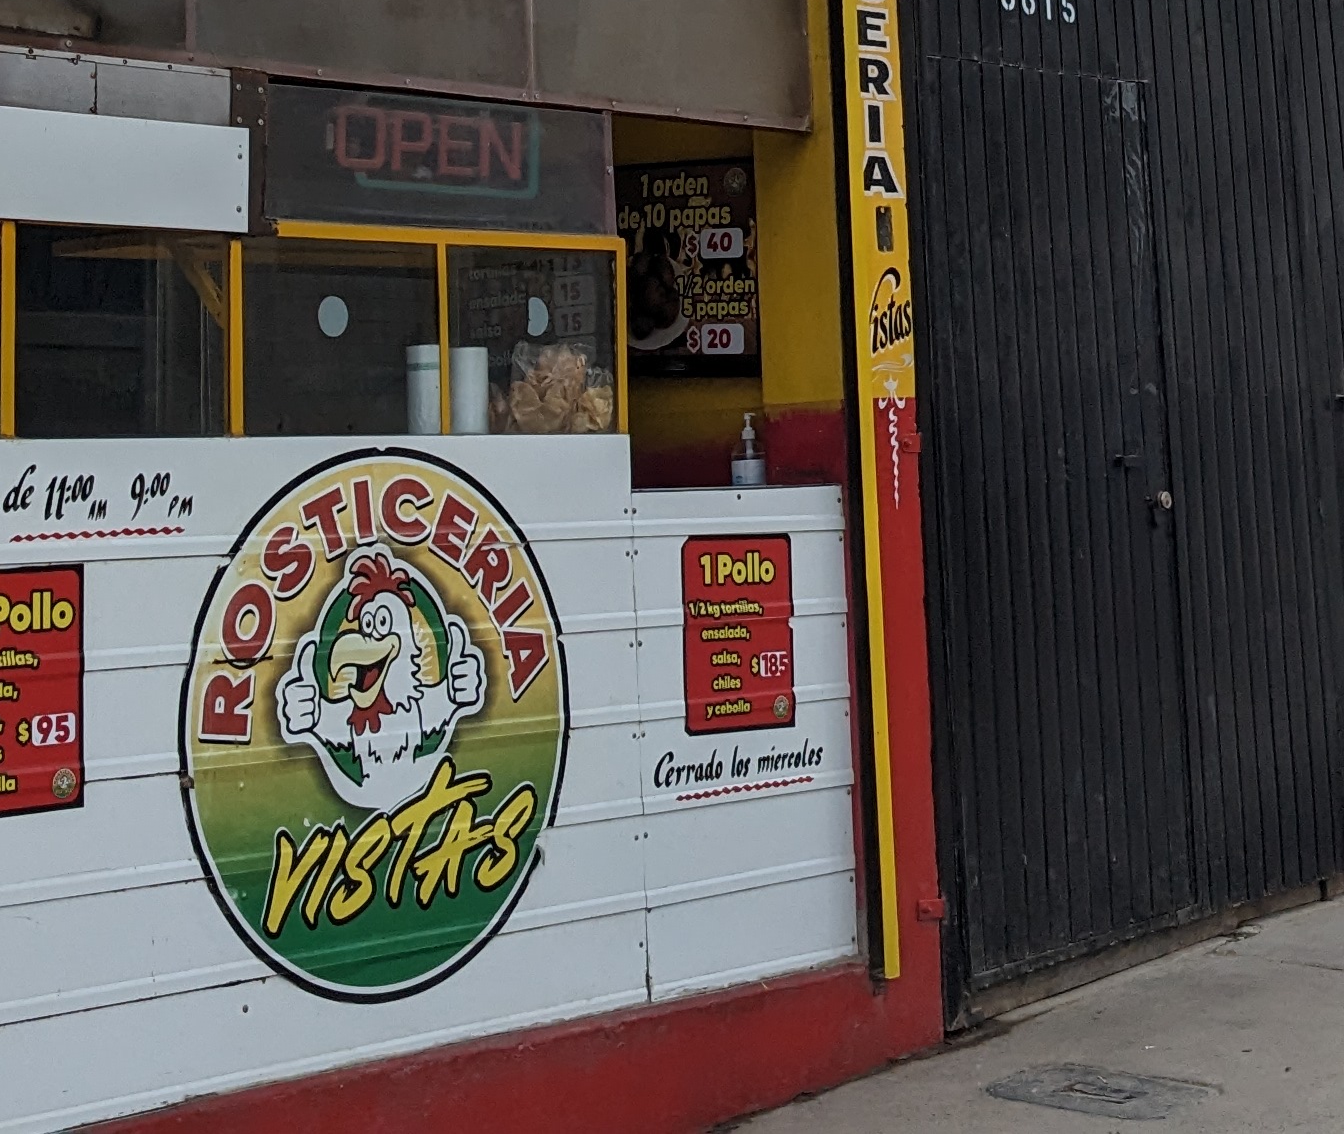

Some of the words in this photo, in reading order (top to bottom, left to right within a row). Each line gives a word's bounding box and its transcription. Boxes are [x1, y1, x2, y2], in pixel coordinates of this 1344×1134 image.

[335, 106, 522, 180] OPEN
[641, 174, 648, 197] 1
[653, 172, 708, 195] orden
[618, 206, 639, 229] de
[644, 203, 665, 228] 10
[670, 206, 730, 233] papas
[677, 276, 704, 296] 1/2
[706, 276, 755, 294] orden
[683, 299, 693, 316] 5
[697, 301, 749, 319] papas
[3, 464, 36, 513] de
[700, 555, 711, 584] 1
[718, 552, 775, 584] Pollo
[199, 476, 549, 744] ROSTICERIA
[689, 602, 706, 616] 1/2
[707, 602, 720, 617] kg
[721, 600, 763, 614] tortillas,
[702, 625, 750, 640] ensalada,
[712, 650, 741, 665] salsa,
[713, 675, 741, 690] chiles
[707, 705, 714, 719] y
[715, 700, 750, 715] cebolla
[654, 749, 723, 789] Cerrado
[731, 745, 750, 778] los
[757, 738, 824, 775] miercoles
[263, 757, 537, 936] VISTAS
